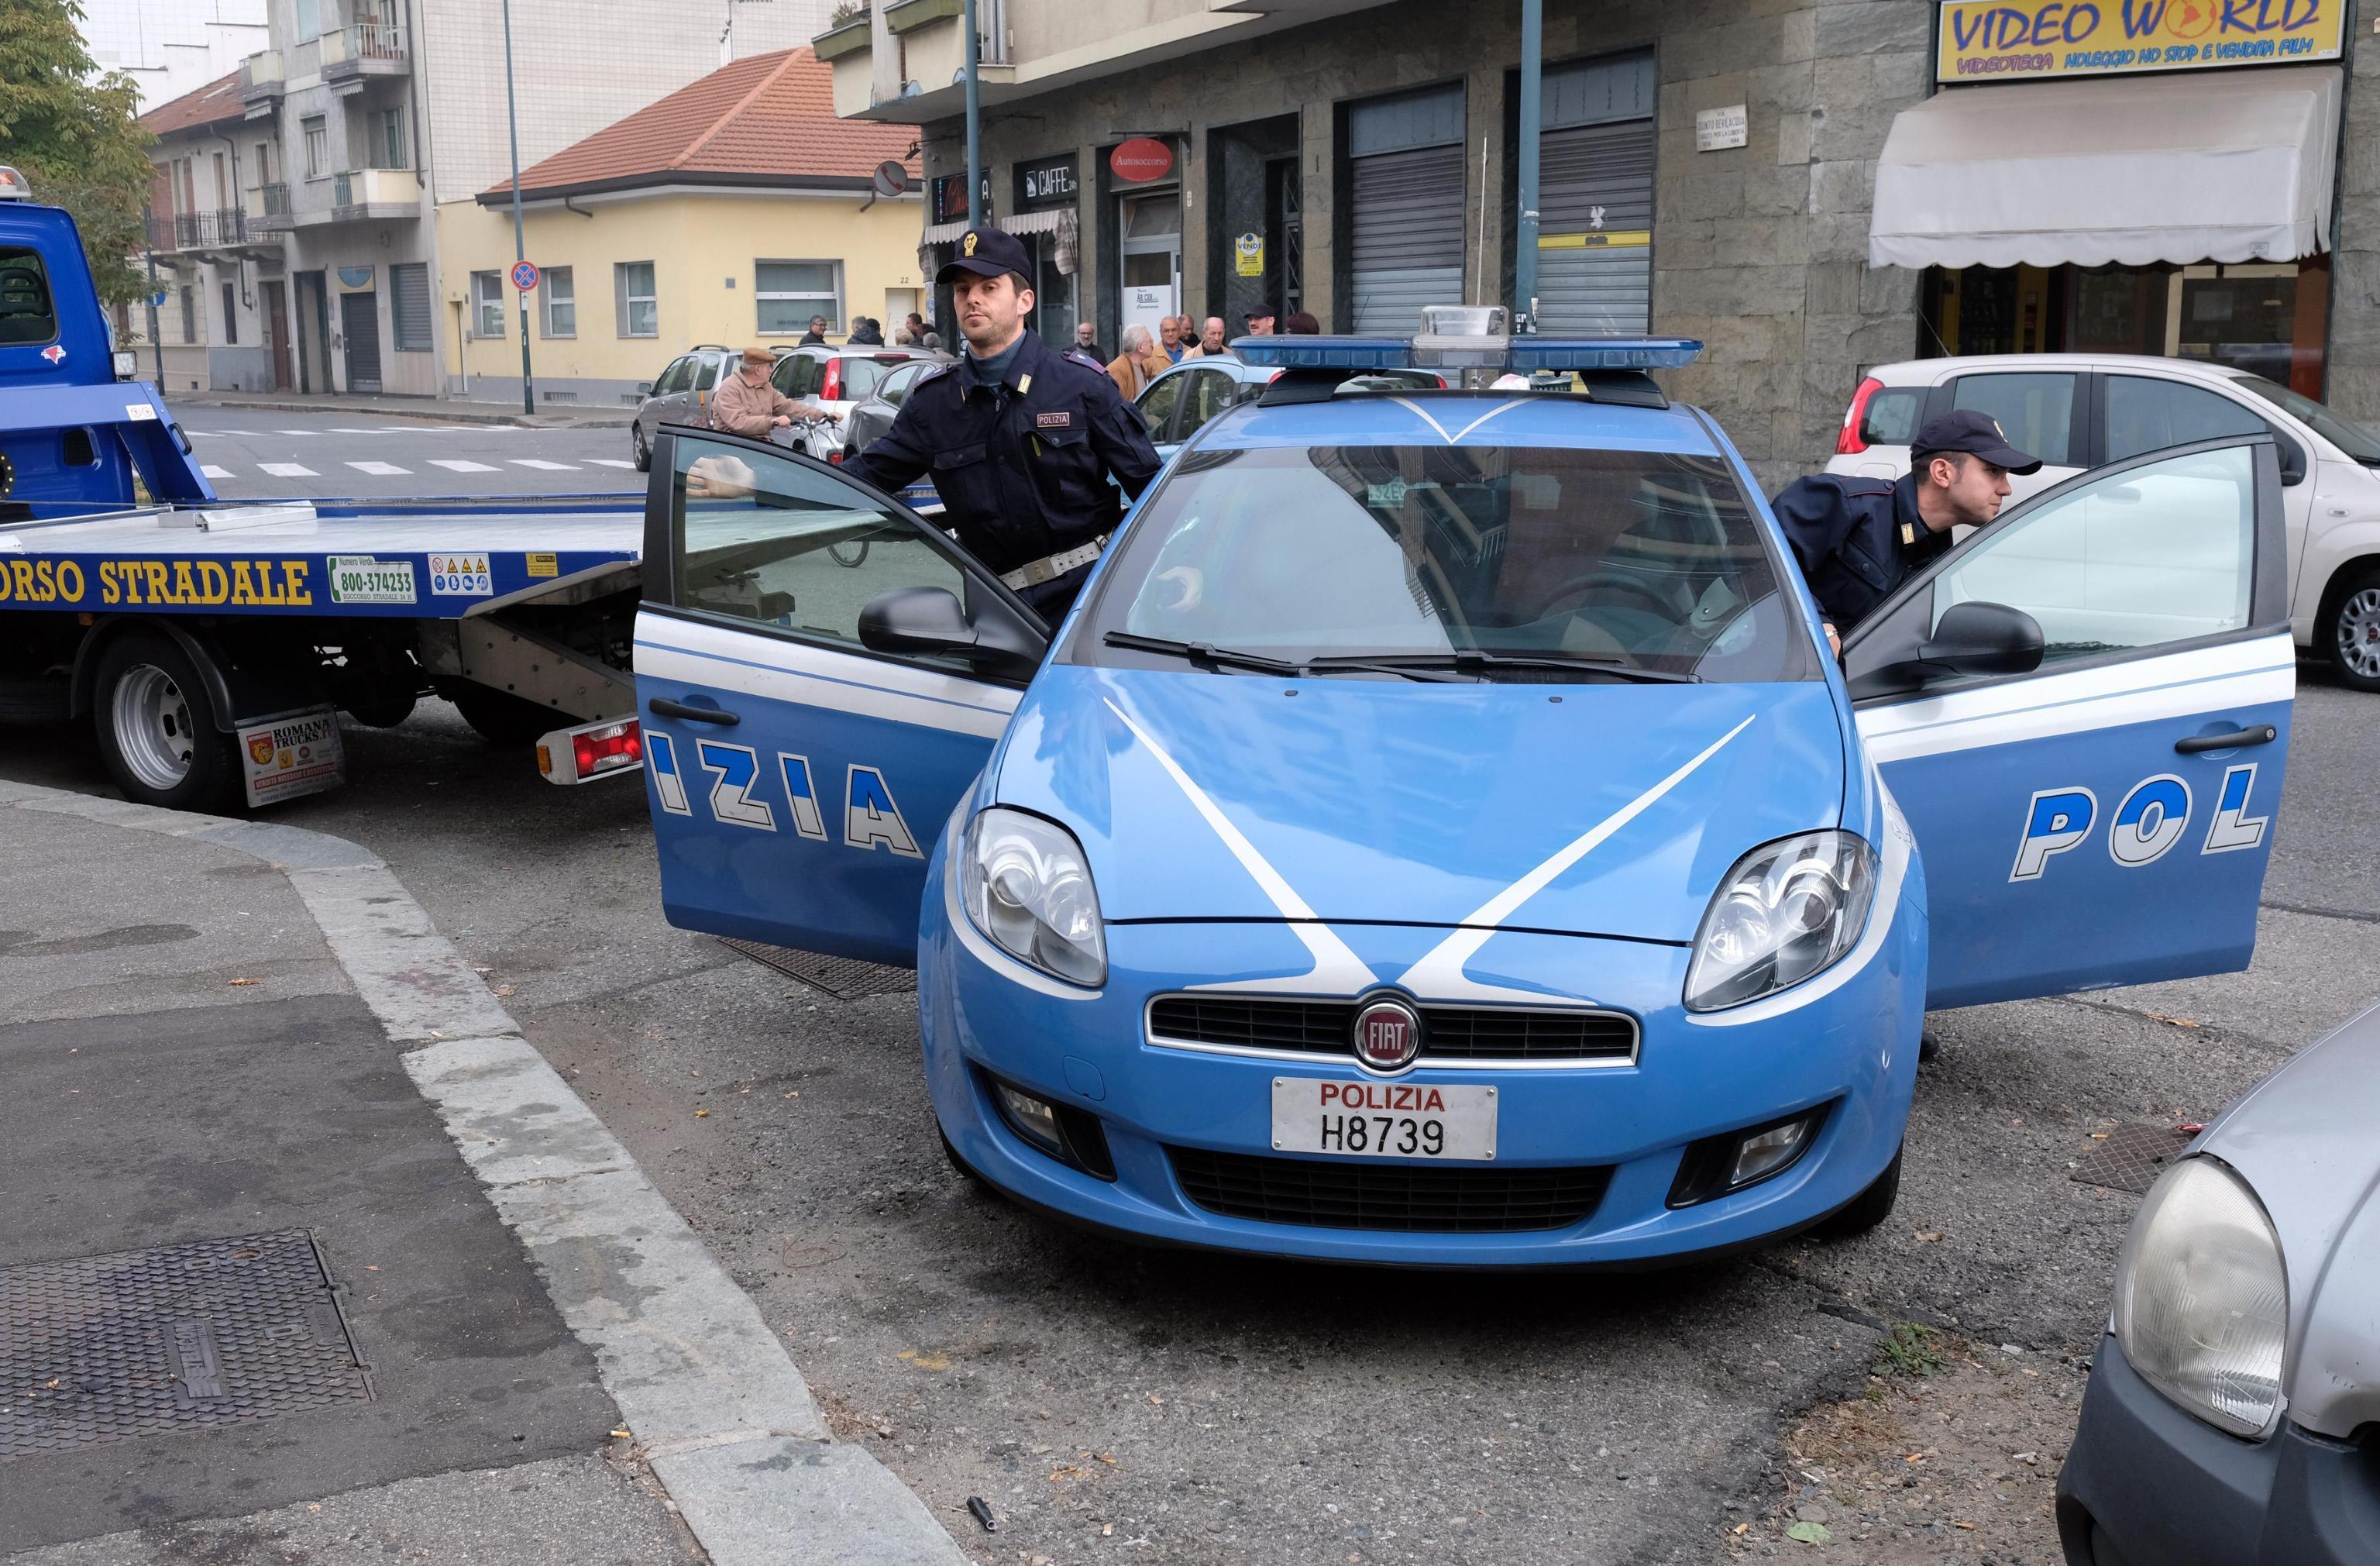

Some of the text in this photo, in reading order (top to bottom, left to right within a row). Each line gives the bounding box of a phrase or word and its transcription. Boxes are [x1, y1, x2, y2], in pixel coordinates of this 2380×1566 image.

[1953, 3, 2100, 51] VIDEO
[1957, 38, 2314, 74] VIDEOTECA NOLEGGIO NO STOP E VENDITA FILM
[1116, 155, 1168, 166] Autosoccorso
[1068, 180, 1078, 191] 24h
[1039, 415, 1068, 425] POLIZIA
[339, 557, 374, 566] Numero Verde
[99, 561, 312, 605] STRADALE
[341, 572, 411, 592] 800-374233
[273, 718, 330, 739] ROMANA
[643, 729, 925, 859] IZIA
[2008, 762, 2268, 883] POL
[1369, 1022, 1405, 1050] FIAT
[1320, 1082, 1446, 1112] POLIZIA
[1321, 1114, 1445, 1155] H8739
